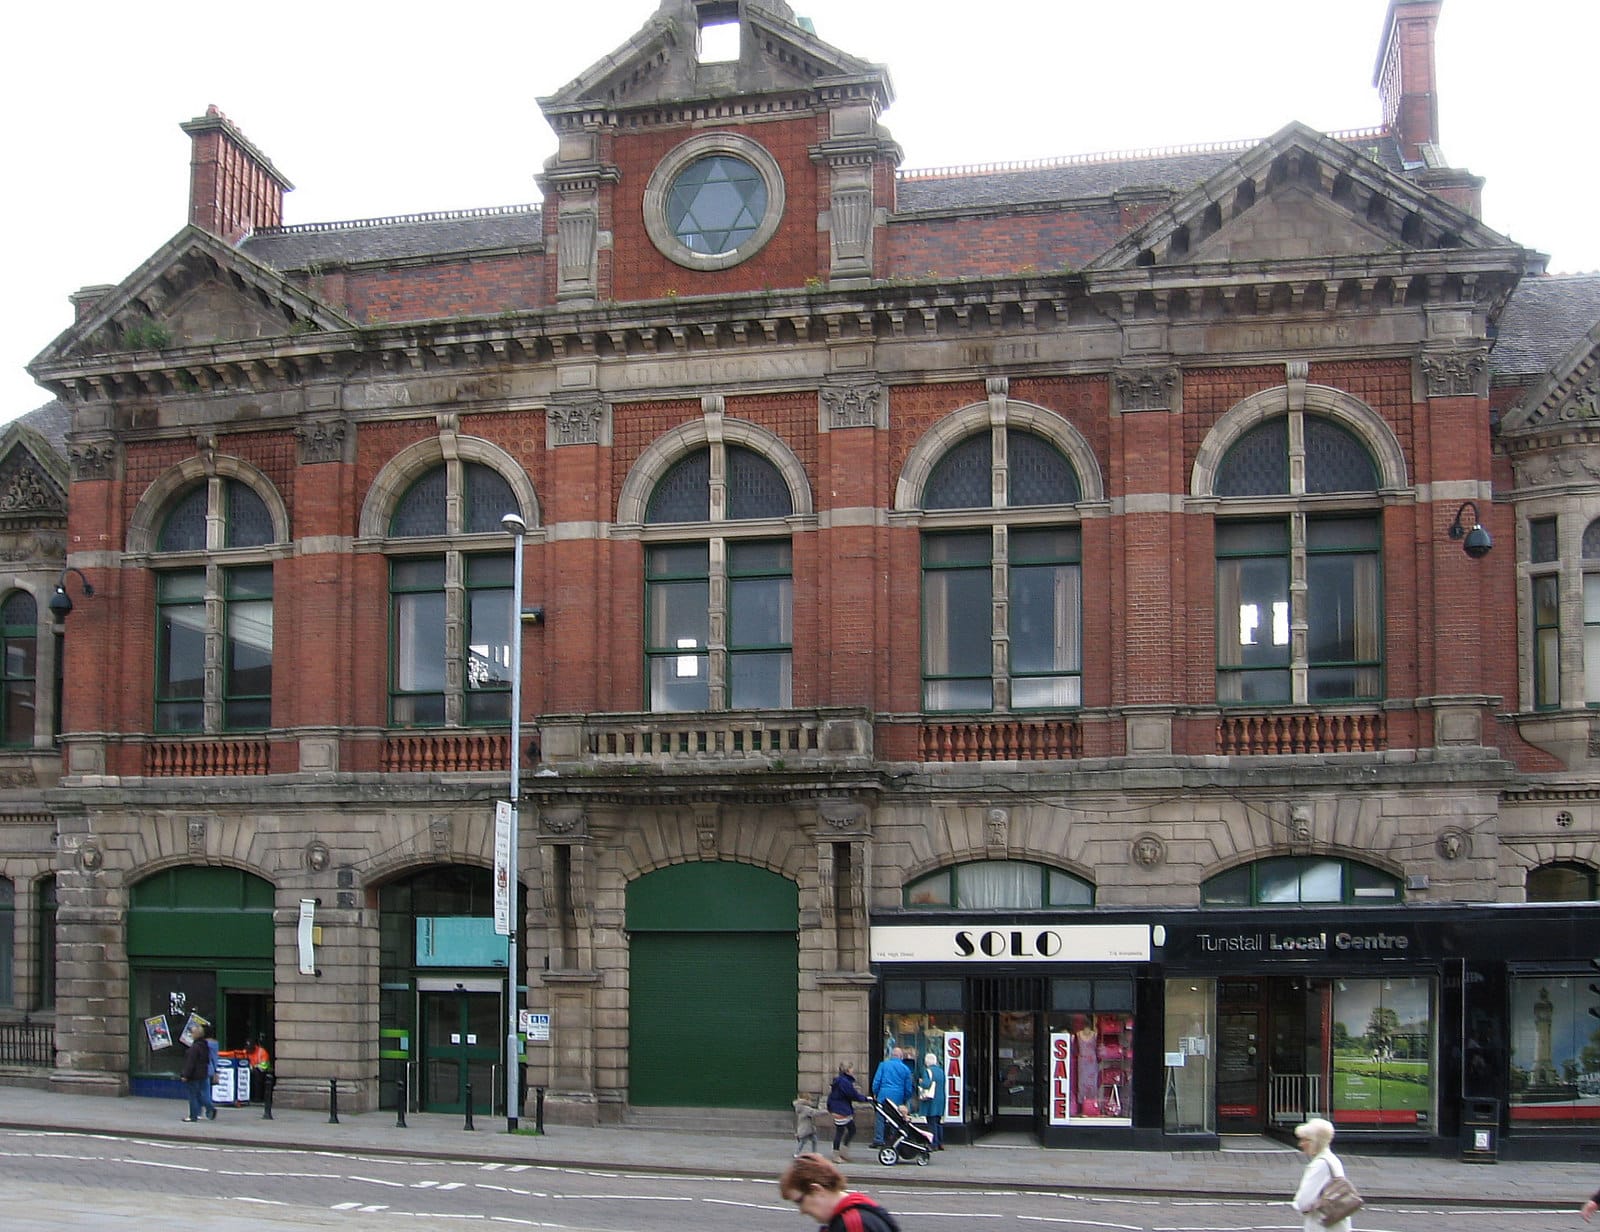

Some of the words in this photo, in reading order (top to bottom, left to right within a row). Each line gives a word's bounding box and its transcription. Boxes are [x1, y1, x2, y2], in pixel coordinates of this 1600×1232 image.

[954, 930, 1062, 957] SOLO
[1197, 934, 1262, 951] Tunstall
[1269, 933, 1327, 950] Local
[1335, 932, 1409, 950] Centre
[947, 1037, 961, 1117] SALE
[1053, 1039, 1068, 1119] SALE
